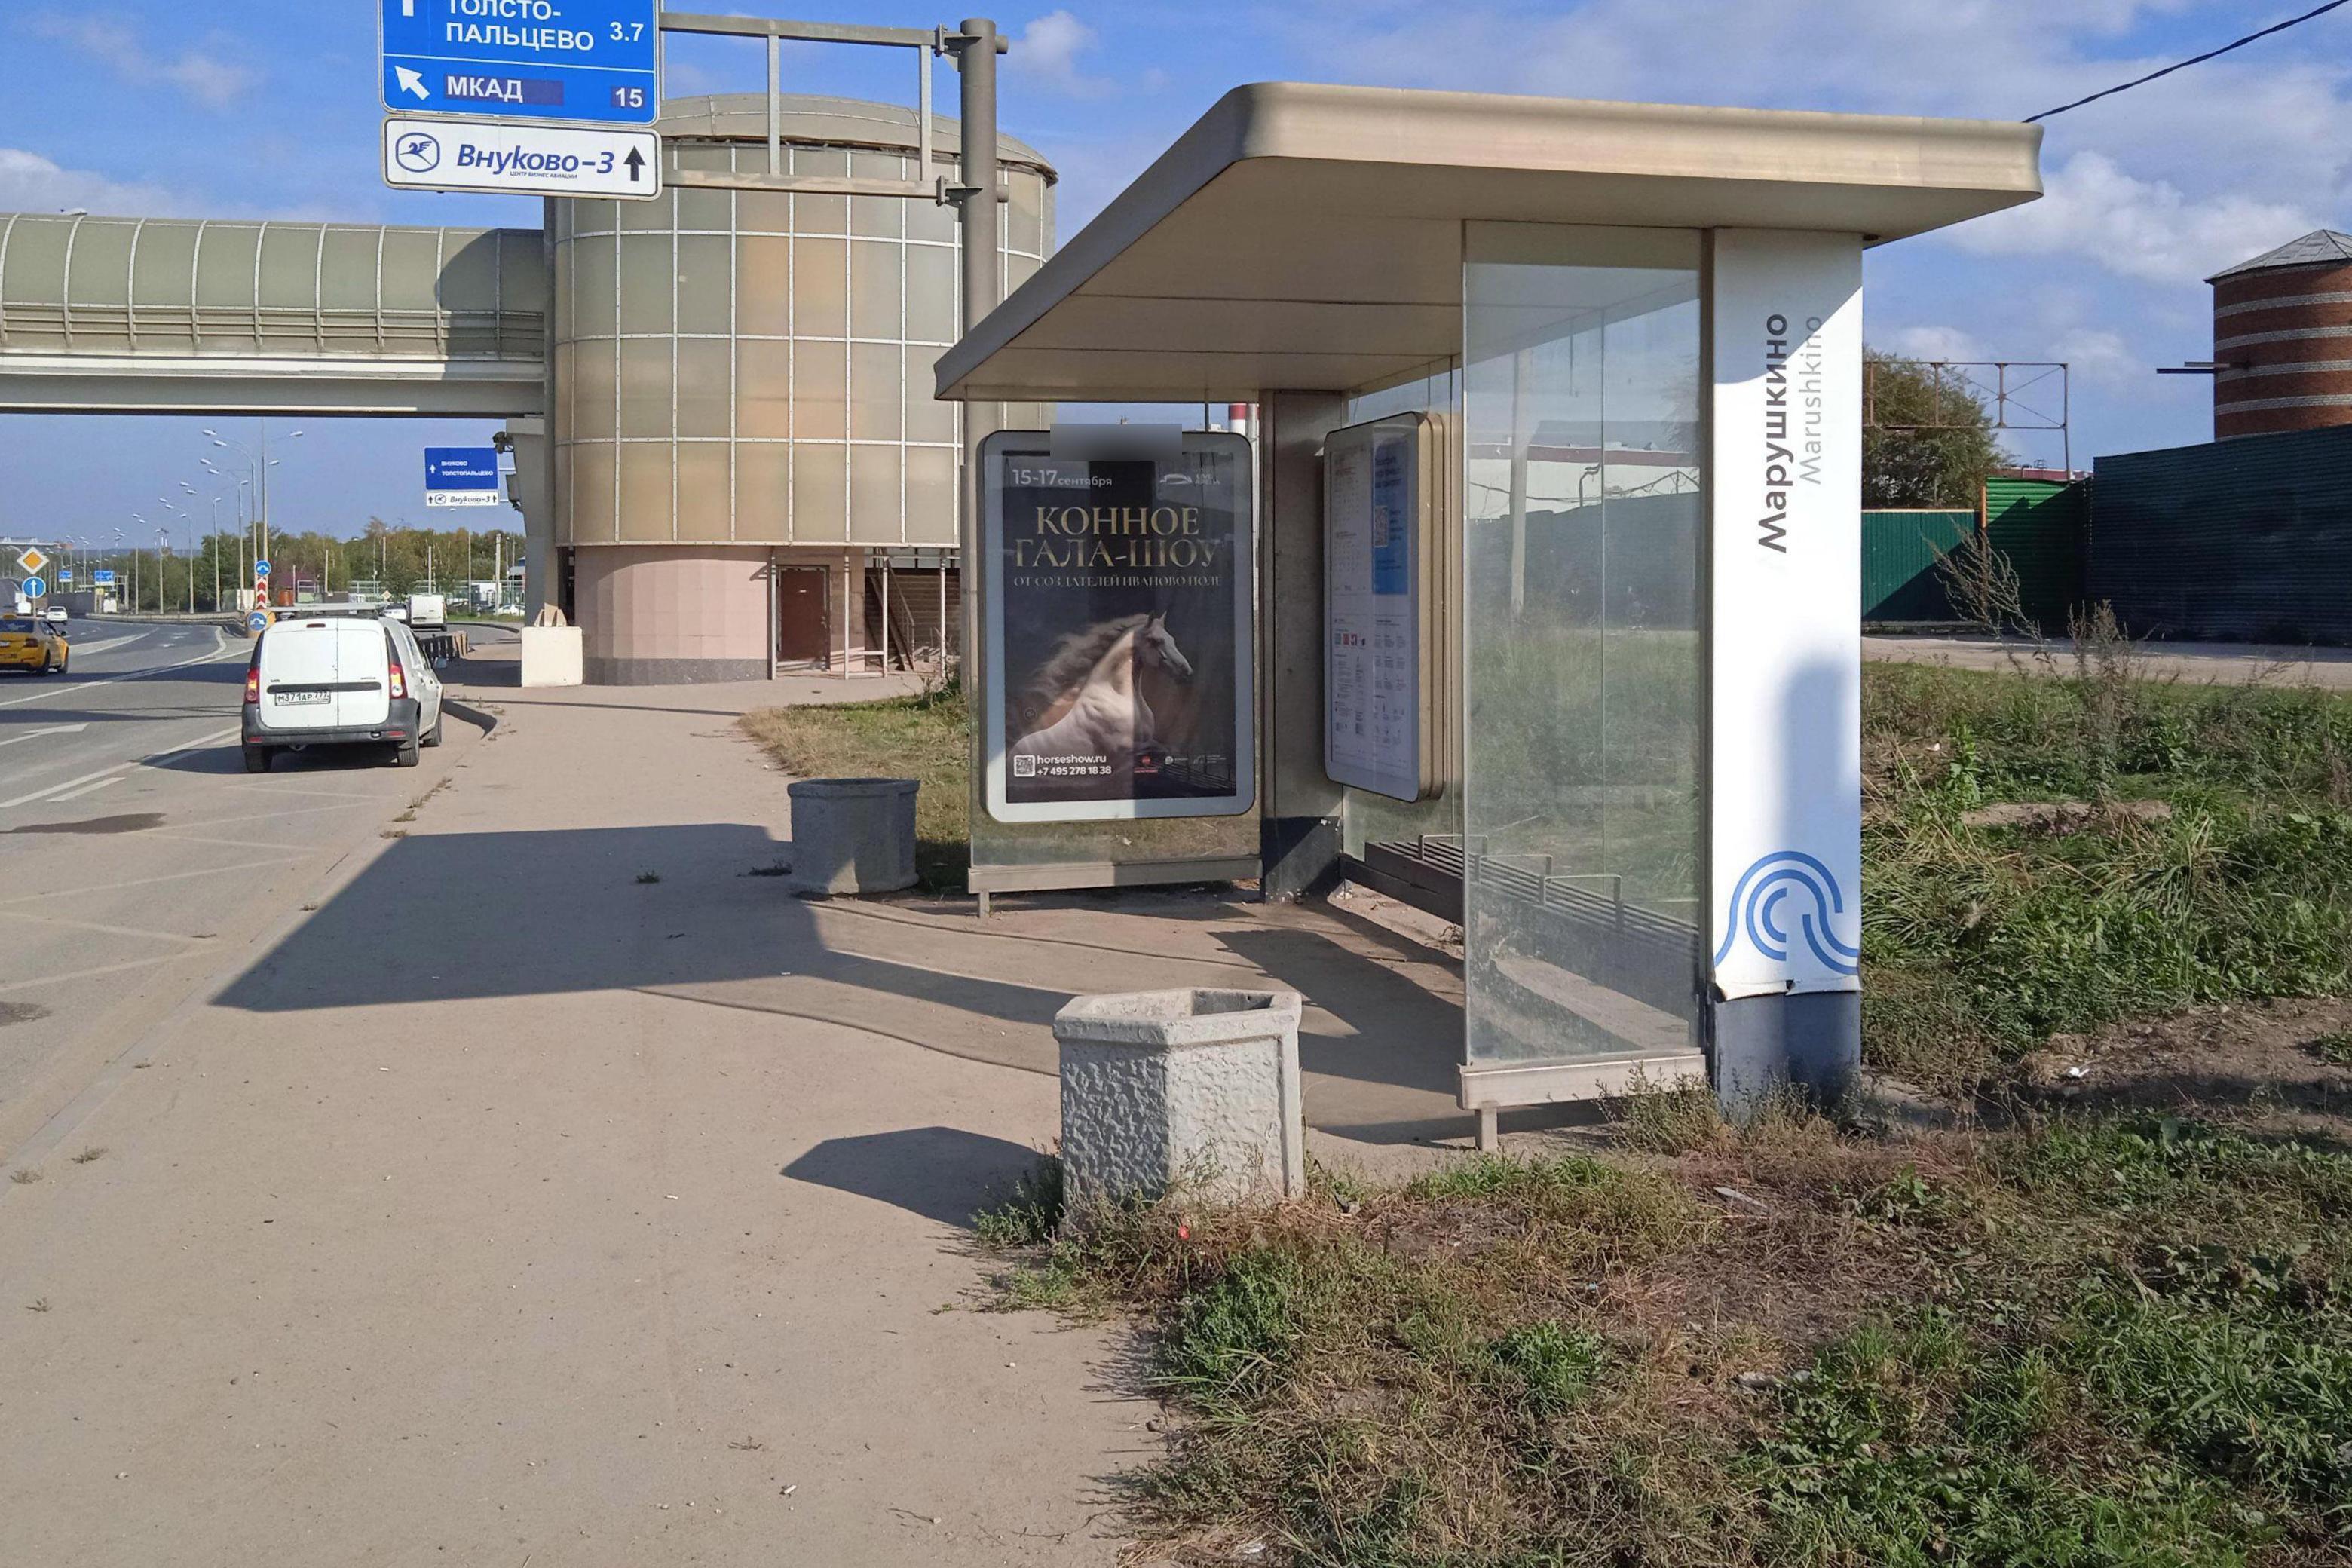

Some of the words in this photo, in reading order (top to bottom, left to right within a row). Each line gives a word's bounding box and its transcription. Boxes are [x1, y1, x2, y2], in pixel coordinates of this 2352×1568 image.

[446, 22, 594, 51] ПАЛЬЦЕВО
[609, 21, 645, 42] 3.7
[447, 75, 523, 103] МКАД
[615, 87, 643, 108] 15
[457, 144, 615, 175] Внуково-3
[1799, 316, 1821, 485] Marushkino
[1758, 314, 1794, 553] Марушкино
[1012, 470, 1058, 485] 15-17
[1058, 476, 1113, 488] сентября
[450, 495, 490, 504] Внуково-3
[1035, 506, 1199, 536] КОННОЕ
[1015, 538, 1221, 567] ГАЛА-ШОУ
[1014, 576, 1033, 587] ОТ
[1037, 754, 1107, 764] horseshow.ru
[1037, 767, 1049, 776] +7
[1050, 767, 1068, 776] 495
[1069, 766, 1086, 775] 278
[1088, 766, 1098, 775] 18
[1099, 766, 1112, 775] 38
